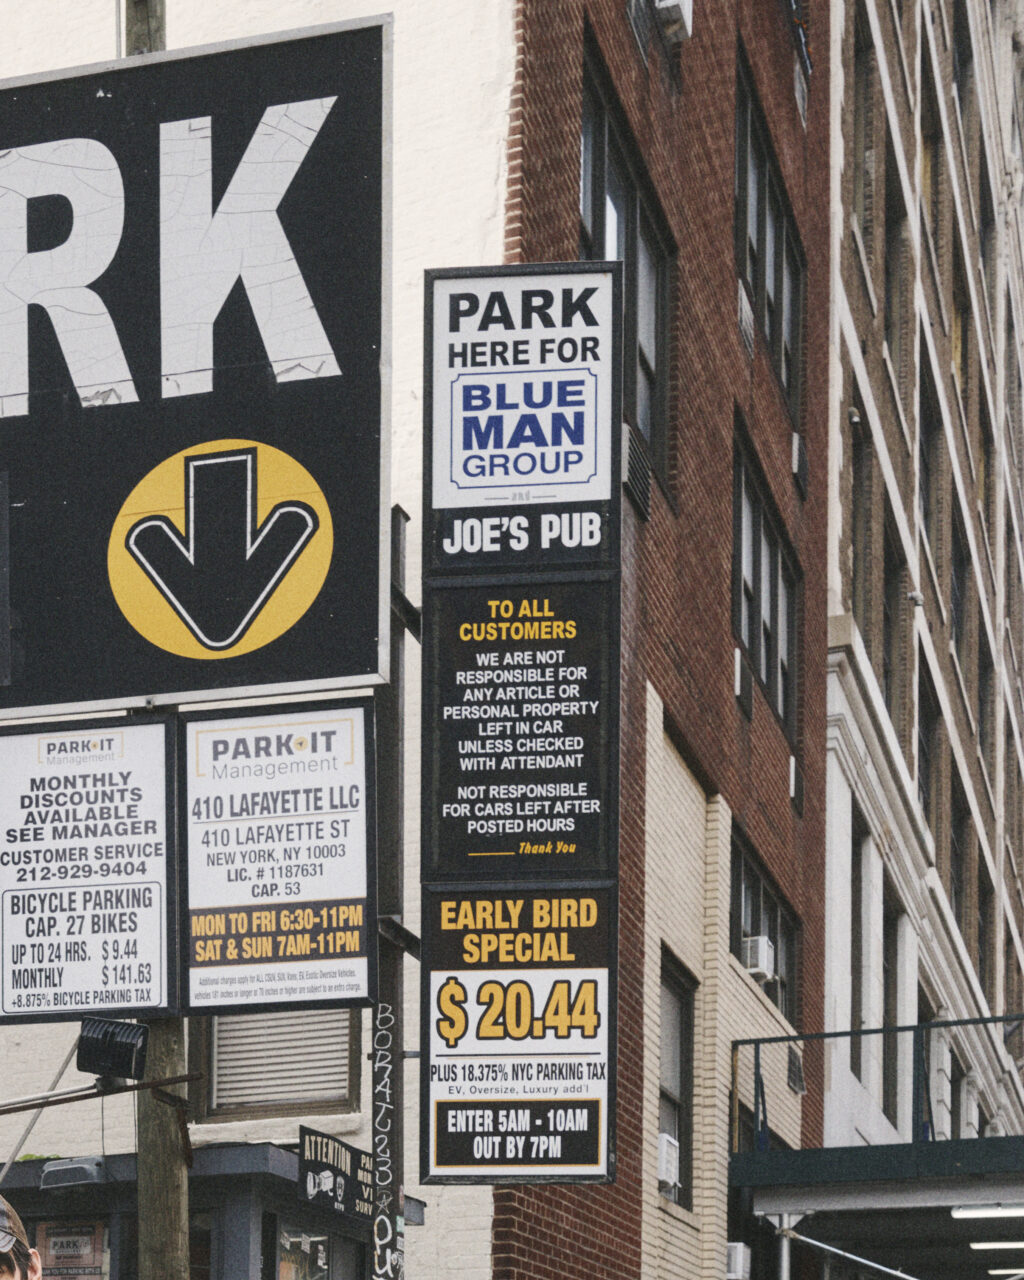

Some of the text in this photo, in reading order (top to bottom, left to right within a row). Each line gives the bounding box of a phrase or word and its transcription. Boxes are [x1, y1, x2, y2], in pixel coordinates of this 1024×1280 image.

[449, 287, 599, 333] PARK
[449, 337, 600, 368] HERE FOR
[463, 380, 585, 412] BLUE
[463, 411, 584, 451] MAN
[463, 451, 583, 477] GROUP
[443, 512, 601, 554] JOE'S PUB
[488, 599, 554, 618] TO ALL
[460, 620, 576, 641] CUSTOMERS
[476, 650, 565, 666] WE ARE NOT
[456, 666, 587, 684] RESPONSIBLE FOR
[463, 684, 579, 701] ANY ARTICLE OR
[444, 701, 598, 719] PERSONAL PROPERTY
[479, 720, 563, 736] LEFT IN CAR
[459, 737, 584, 754] UNLESS CHECKED
[213, 758, 338, 780] Management
[460, 754, 584, 771] WITH ATTENDANT
[30, 771, 131, 792] MONTHLY
[458, 783, 587, 799] NOT RESPONSIBLE
[21, 787, 142, 809] DISCOUNTS
[192, 784, 359, 820] 410 LAFAYETTE LLC
[443, 800, 600, 817] FOR CARS LEFT AFTER
[24, 804, 138, 826] AVAILABLE
[468, 818, 574, 833] POSTED HOURS
[6, 820, 156, 844] SEE MANAGER
[202, 819, 350, 848] 410 LAFAYETTE ST
[0, 842, 163, 866] CUSTOMER SERVICE
[207, 844, 345, 867] NEW YORK, NY 10003
[520, 841, 576, 854] Thank You
[17, 861, 147, 882] 212-929-9404
[228, 863, 323, 882] LIC. # 1187631
[11, 887, 152, 915] BICYCLE PARKING
[252, 882, 300, 898] CAP. 53
[26, 912, 137, 938] CAP. 27 BIKES
[192, 905, 362, 936] MON TO FRI 6:30-11PM
[441, 898, 597, 930] EARLY BIRD
[196, 930, 359, 962] SAT & SUN 7AM-11PM
[463, 932, 575, 963] SPECIAL
[54, 991, 90, 1006] BICYCLE
[93, 989, 131, 1004] PARKING
[135, 988, 151, 1002] TAX
[436, 976, 601, 1049] $ 20.44
[430, 1062, 606, 1083] PLUS 18.375% NYC PARKING TAX
[448, 1086, 465, 1095] EV,
[470, 1085, 518, 1094] Oversize,
[523, 1085, 558, 1095] Luxury
[448, 1109, 588, 1132] ENTER 5AM 10AM
[304, 1135, 352, 1176] ATTENTION
[474, 1136, 561, 1159] OUT BY 7PM
